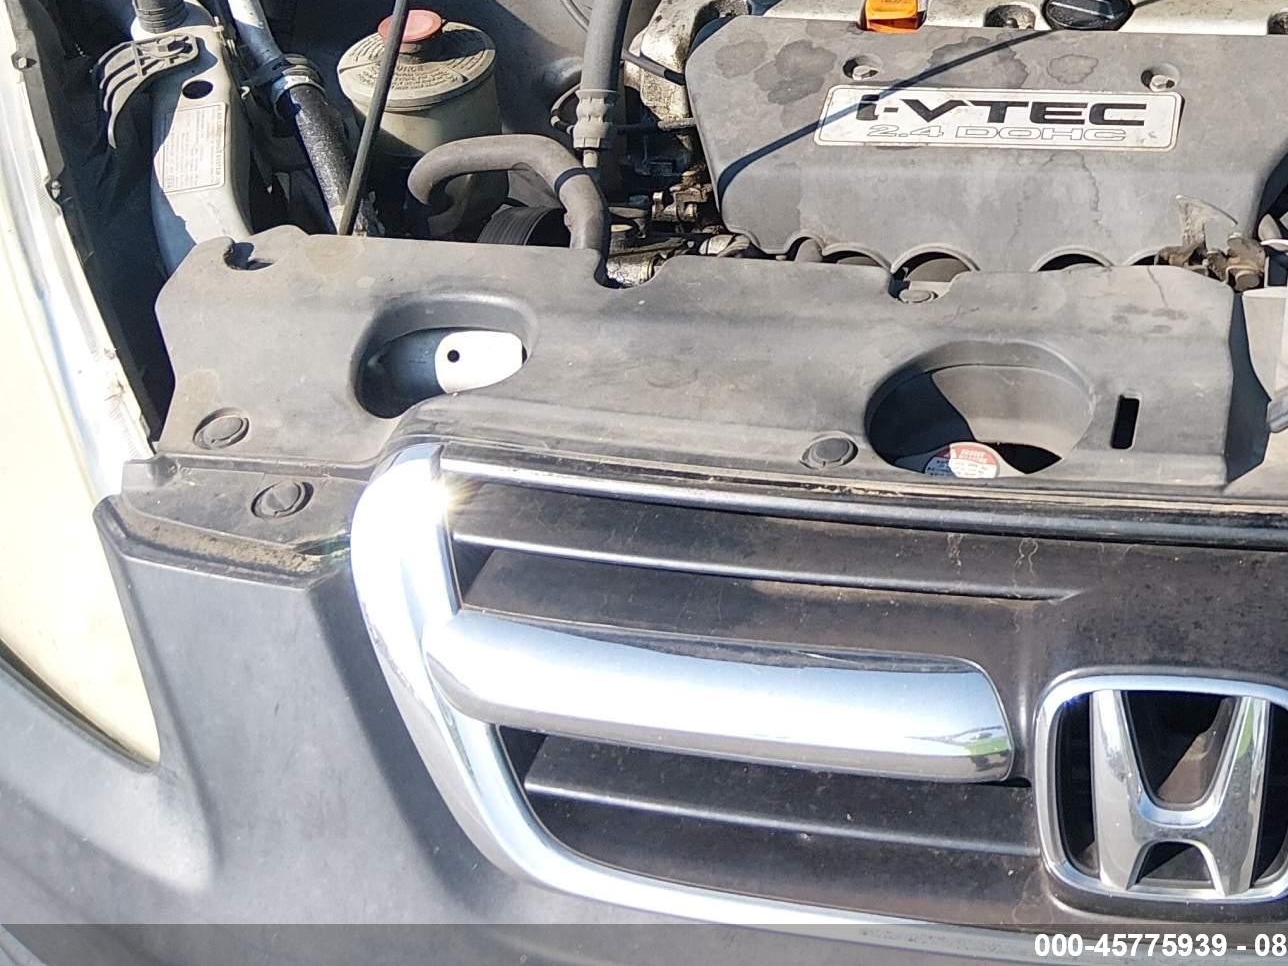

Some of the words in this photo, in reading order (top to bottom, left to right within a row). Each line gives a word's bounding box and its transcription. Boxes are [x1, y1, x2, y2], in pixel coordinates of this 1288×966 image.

[855, 94, 1146, 126] i-VTEC
[866, 124, 944, 138] 2.4
[955, 125, 1127, 141] DOHC
